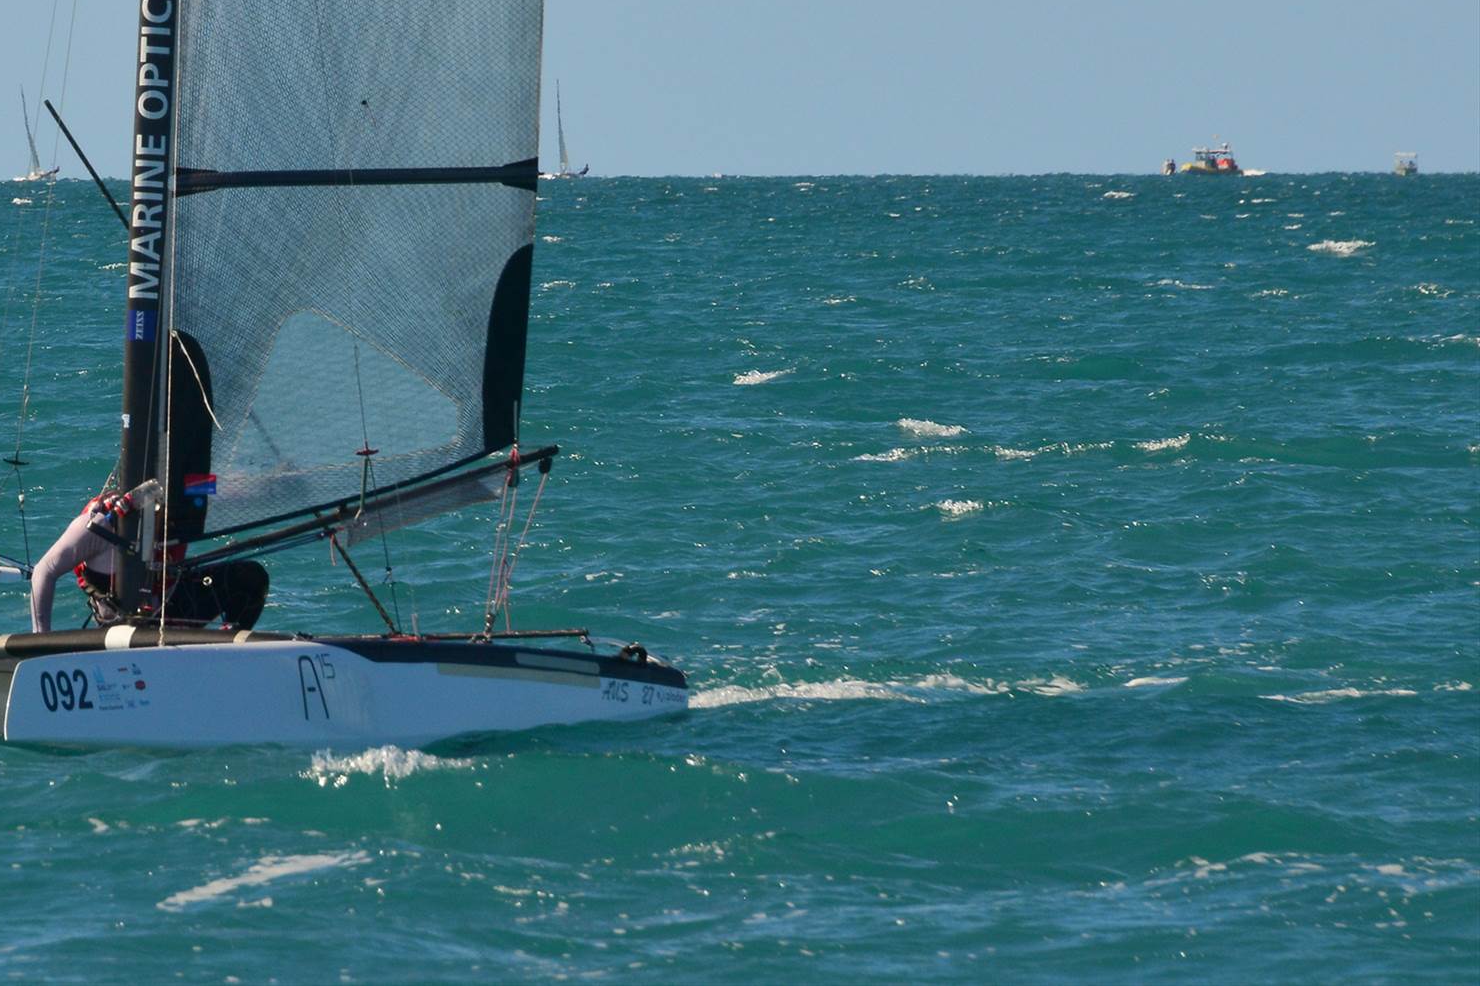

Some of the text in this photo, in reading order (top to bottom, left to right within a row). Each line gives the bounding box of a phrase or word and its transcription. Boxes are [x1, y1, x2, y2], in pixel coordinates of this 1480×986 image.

[129, 134, 166, 300] MARINE
[135, 310, 144, 340] ZEISS
[40, 668, 94, 712] 092
